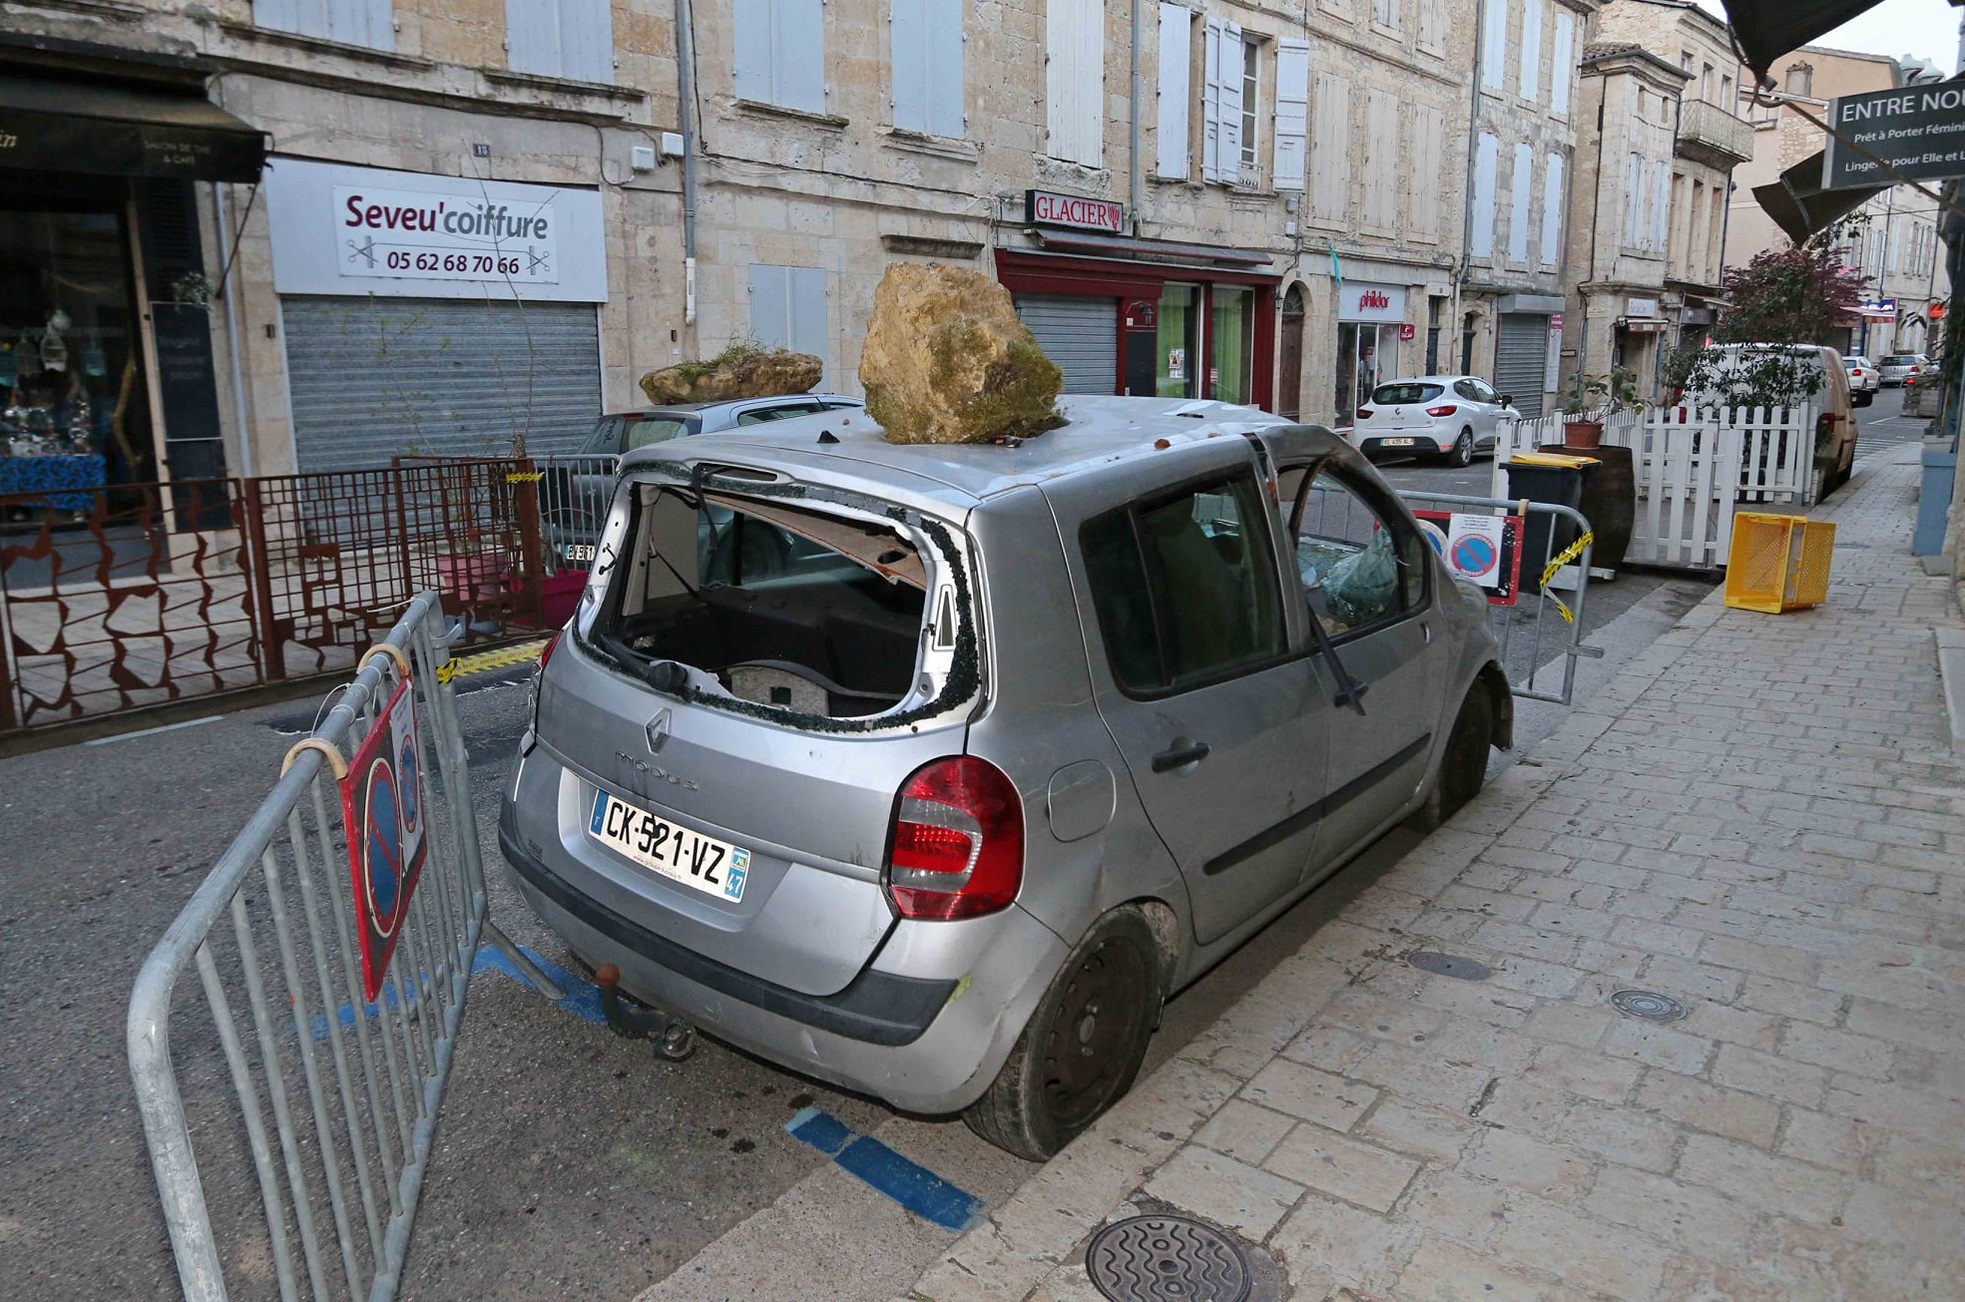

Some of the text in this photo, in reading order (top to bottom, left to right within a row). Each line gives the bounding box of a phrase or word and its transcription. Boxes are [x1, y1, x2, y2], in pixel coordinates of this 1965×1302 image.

[1842, 95, 1916, 122] ENTRE
[1854, 131, 1877, 143] Prêt
[1878, 130, 1886, 140] à
[1887, 127, 1924, 139] Porter
[1845, 159, 1890, 172] Lingee
[1892, 155, 1920, 168] pour
[1922, 152, 1942, 163] Elle
[1945, 152, 1957, 161] et
[1035, 196, 1108, 226] GLACIER
[387, 252, 519, 274] 05 62 68 70 66
[606, 802, 726, 885] CK-521-VZ
[726, 872, 744, 895] 47
